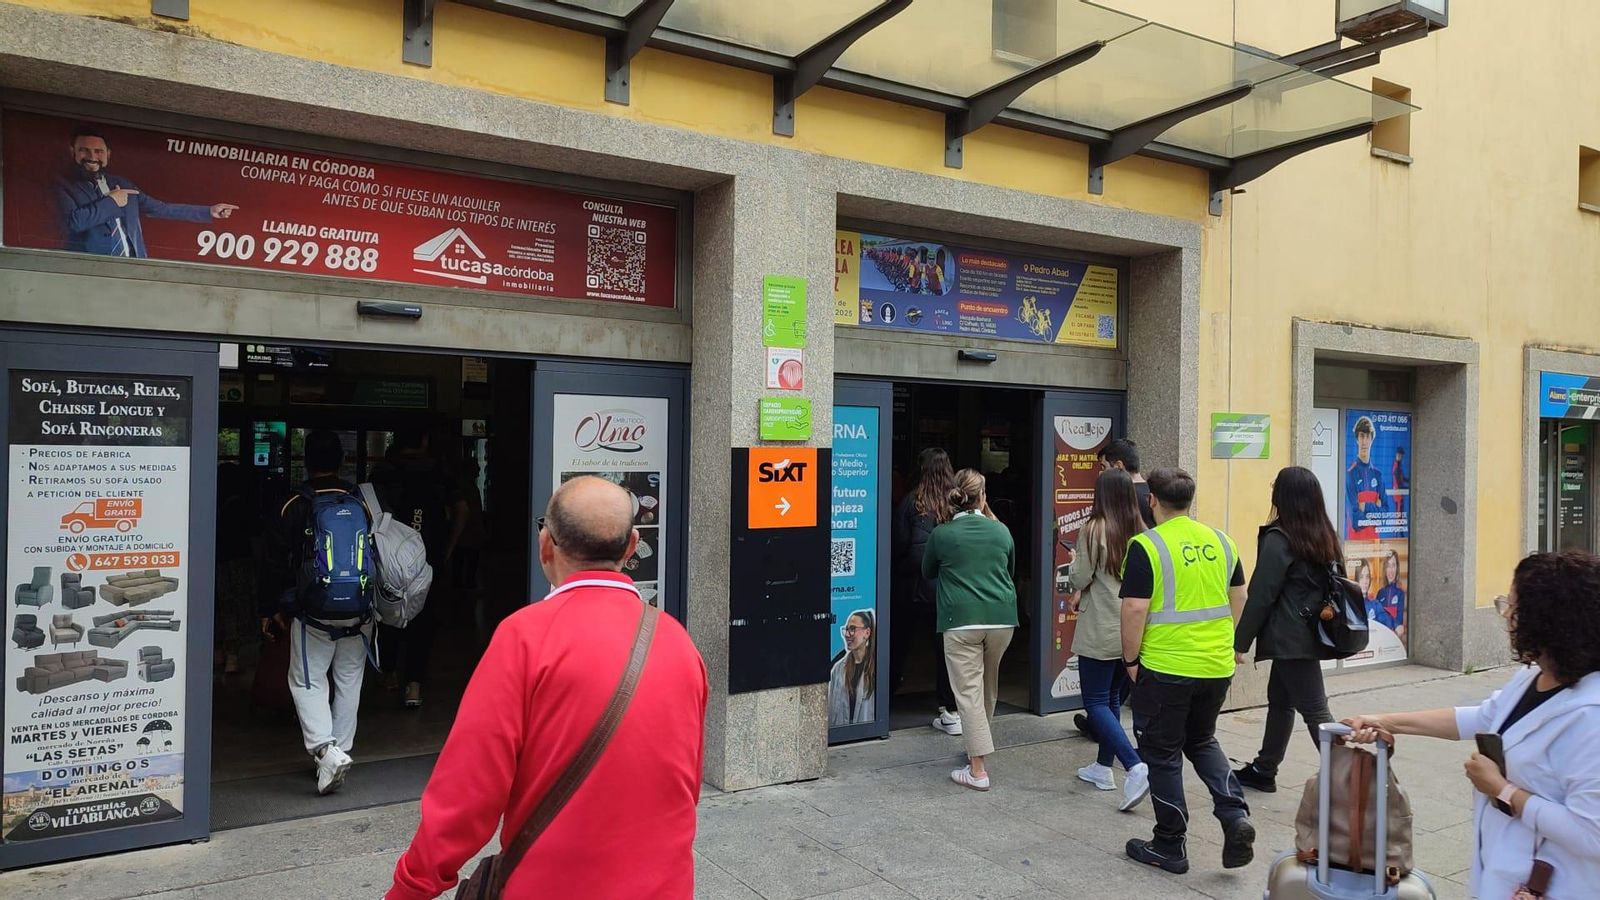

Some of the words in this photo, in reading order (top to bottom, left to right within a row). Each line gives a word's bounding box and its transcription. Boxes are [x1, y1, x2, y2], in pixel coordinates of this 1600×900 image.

[167, 138, 186, 153] TU
[188, 142, 288, 167] INMOBILIARIA
[292, 157, 309, 170] EN
[312, 159, 375, 180] CÓRDOBA
[241, 165, 296, 184] COMPRA
[299, 173, 307, 185] Y
[308, 175, 340, 190] PAGA
[343, 180, 380, 195] COMO
[382, 185, 393, 197] SI
[395, 187, 430, 202] FUESE
[432, 193, 448, 205] UN
[450, 195, 501, 213] ALQUILER
[322, 193, 360, 208] ANTES
[362, 197, 378, 210] DE
[380, 200, 404, 214] QUE
[406, 203, 445, 219] SUBAN
[447, 209, 467, 222] LOS
[469, 212, 499, 227] TIPOS
[501, 217, 515, 229] DE
[516, 219, 557, 235] INTERÉS
[582, 201, 624, 215] CONSULTA
[592, 213, 628, 227] NUESTRA
[629, 218, 647, 229] WEB
[262, 220, 317, 237] LLAMAD
[319, 227, 379, 244] GRATUITA
[196, 230, 256, 260] 900
[263, 237, 319, 266] 929
[324, 244, 379, 272] 888
[440, 254, 555, 281] tucasacórdoba
[1029, 264, 1051, 276] Pedro
[1051, 267, 1069, 277] Abad
[574, 412, 647, 448] Olmo
[76, 450, 89, 458] DE
[53, 464, 107, 472] ADAPTAMOS
[119, 464, 137, 472] SUS
[840, 459, 864, 468] Medio
[838, 467, 869, 478] Superior
[89, 477, 102, 485] SU
[132, 477, 162, 485] USADO
[106, 490, 144, 498] CLIENTE
[833, 485, 867, 497] futuro
[103, 508, 137, 517] GRATIS
[831, 501, 864, 516] pieza
[58, 534, 90, 544] ENVÍO
[92, 534, 144, 543] GRATUITO
[23, 545, 43, 554] CON
[45, 544, 77, 553] SUBIDA
[86, 543, 124, 552] MONTAJE
[133, 542, 174, 551] DOMICILIO
[1182, 544, 1217, 563] CTC
[94, 555, 119, 567] 647
[123, 555, 148, 566] 593
[151, 554, 175, 565] 033
[38, 692, 100, 707] ¡Descanso
[102, 692, 110, 701] y
[112, 687, 155, 699] máxima
[30, 706, 74, 720] calidad
[76, 704, 87, 715] al
[90, 701, 121, 716] mejor
[123, 698, 163, 712] precio!
[11, 725, 39, 733] VENTA
[41, 723, 53, 731] EN
[54, 721, 71, 730] LOS
[72, 715, 128, 728] MERCADILLOS
[129, 714, 140, 722] DE
[141, 710, 179, 720] CÓRDOBA
[11, 730, 67, 745] MARTES
[70, 730, 79, 741] y
[81, 722, 138, 737] VIERNES
[66, 801, 127, 815] TAPICERÍAS
[51, 805, 140, 829] VILLABLANCA
